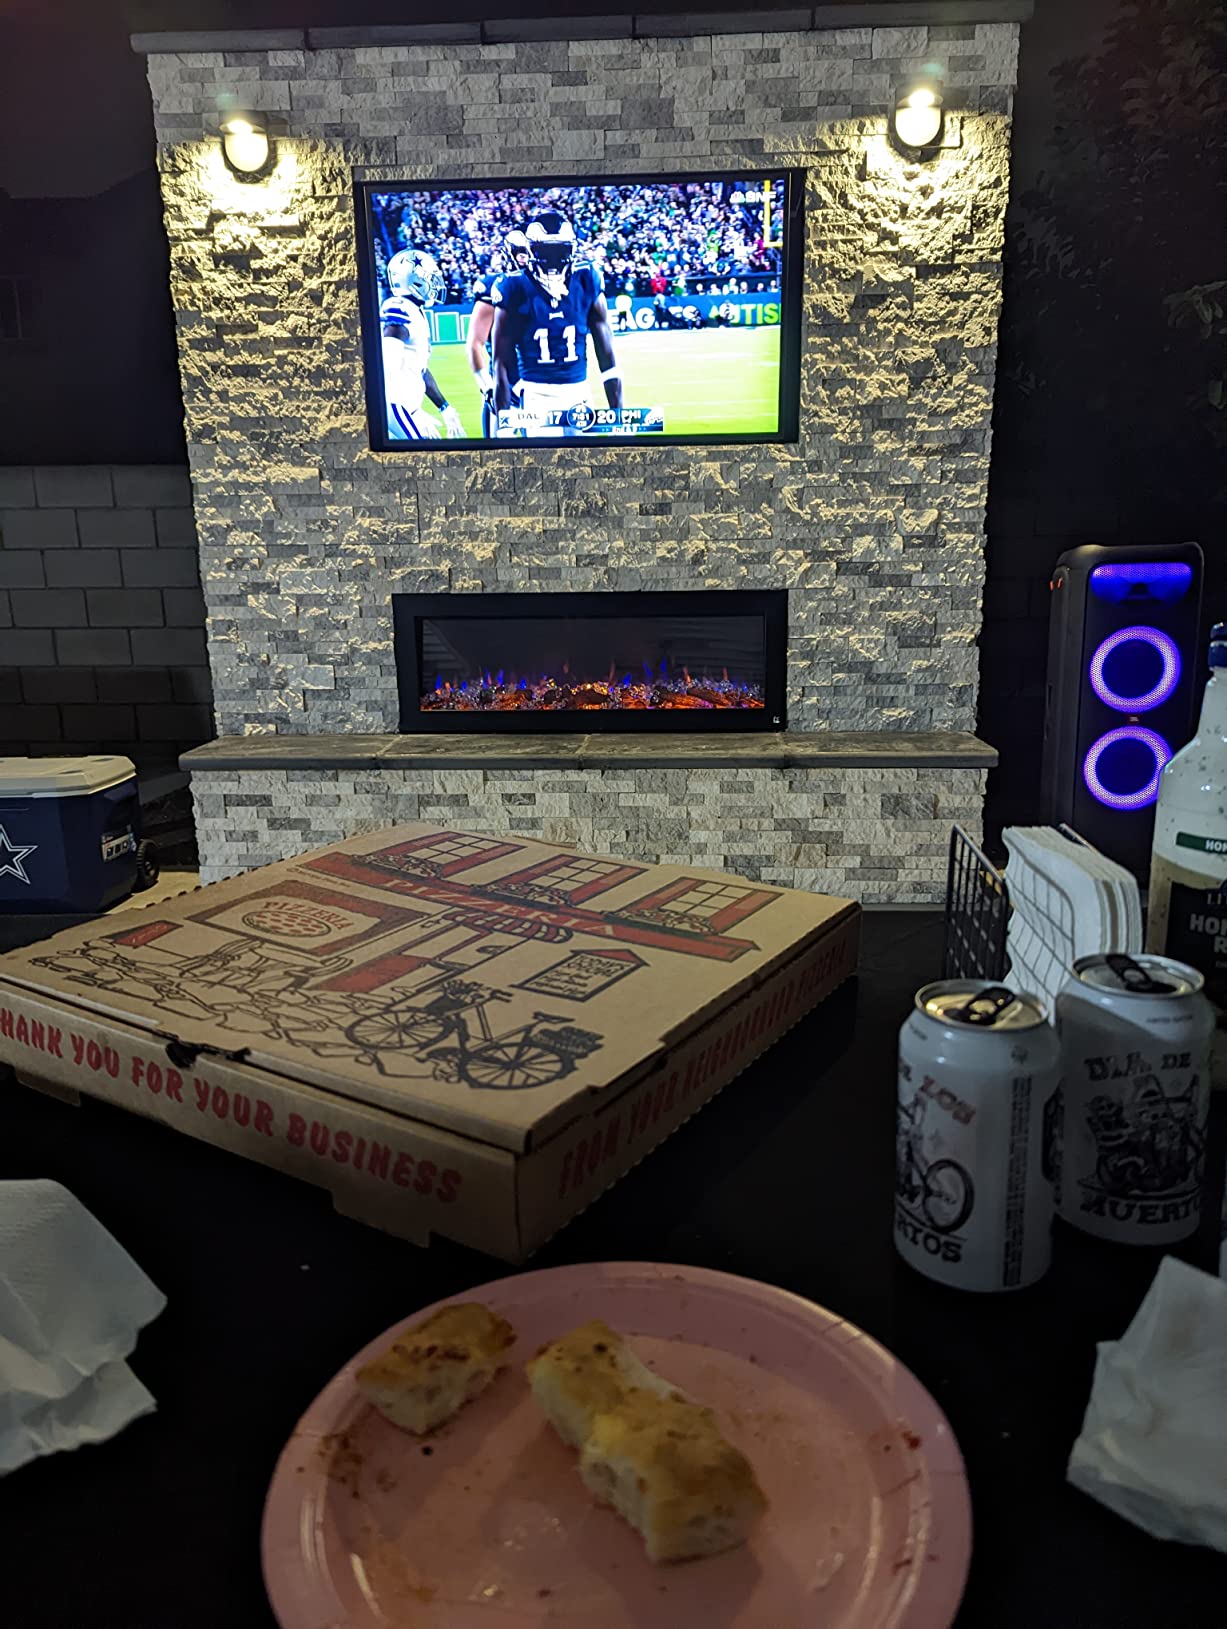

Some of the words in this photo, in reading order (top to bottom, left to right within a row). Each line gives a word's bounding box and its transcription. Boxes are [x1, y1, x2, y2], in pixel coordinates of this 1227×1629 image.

[533, 325, 579, 365] 11
[518, 413, 540, 421] DAL
[549, 411, 563, 425] 17
[597, 410, 616, 424] 20
[263, 902, 354, 930] PIZZERIA
[384, 879, 616, 936] PIZZERIA
[1161, 1052, 1191, 1070] DE
[71, 1034, 120, 1079] YOU
[132, 1057, 184, 1102] FOR
[194, 1078, 274, 1138] YOUR
[286, 1113, 463, 1203] BUSINESS
